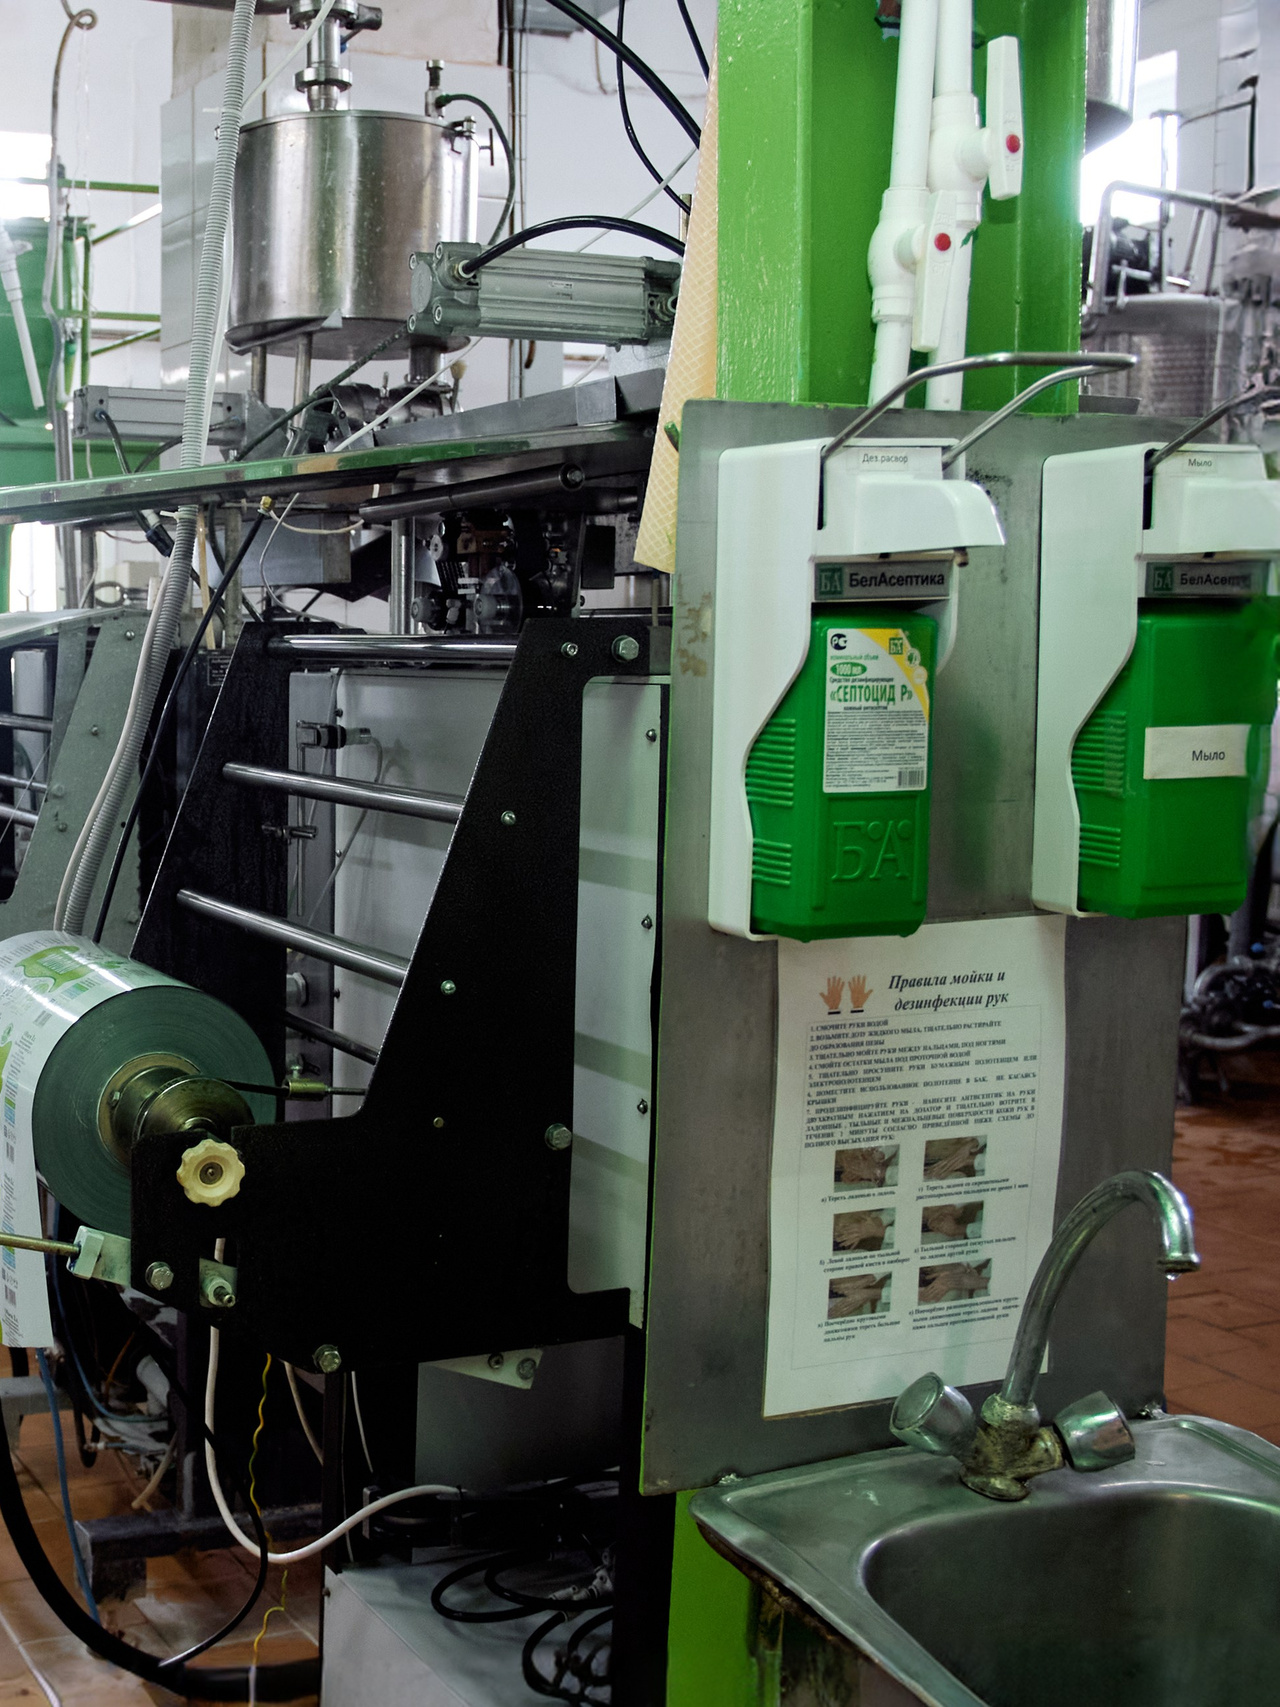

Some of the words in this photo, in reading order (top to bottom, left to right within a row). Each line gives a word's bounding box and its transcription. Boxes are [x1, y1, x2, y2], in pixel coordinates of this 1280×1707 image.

[1188, 458, 1212, 466] Мыло
[849, 572, 944, 588] БелАсептика
[836, 664, 851, 675] 1000
[830, 685, 895, 705] «СЕПТОЦИД
[900, 685, 913, 701] Р»
[1192, 750, 1225, 761] Мыло
[888, 974, 946, 990] Правила
[949, 970, 993, 984] мойки
[997, 972, 1005, 982] и
[894, 992, 982, 1012] дезинфекции
[986, 992, 1009, 1008] рук
